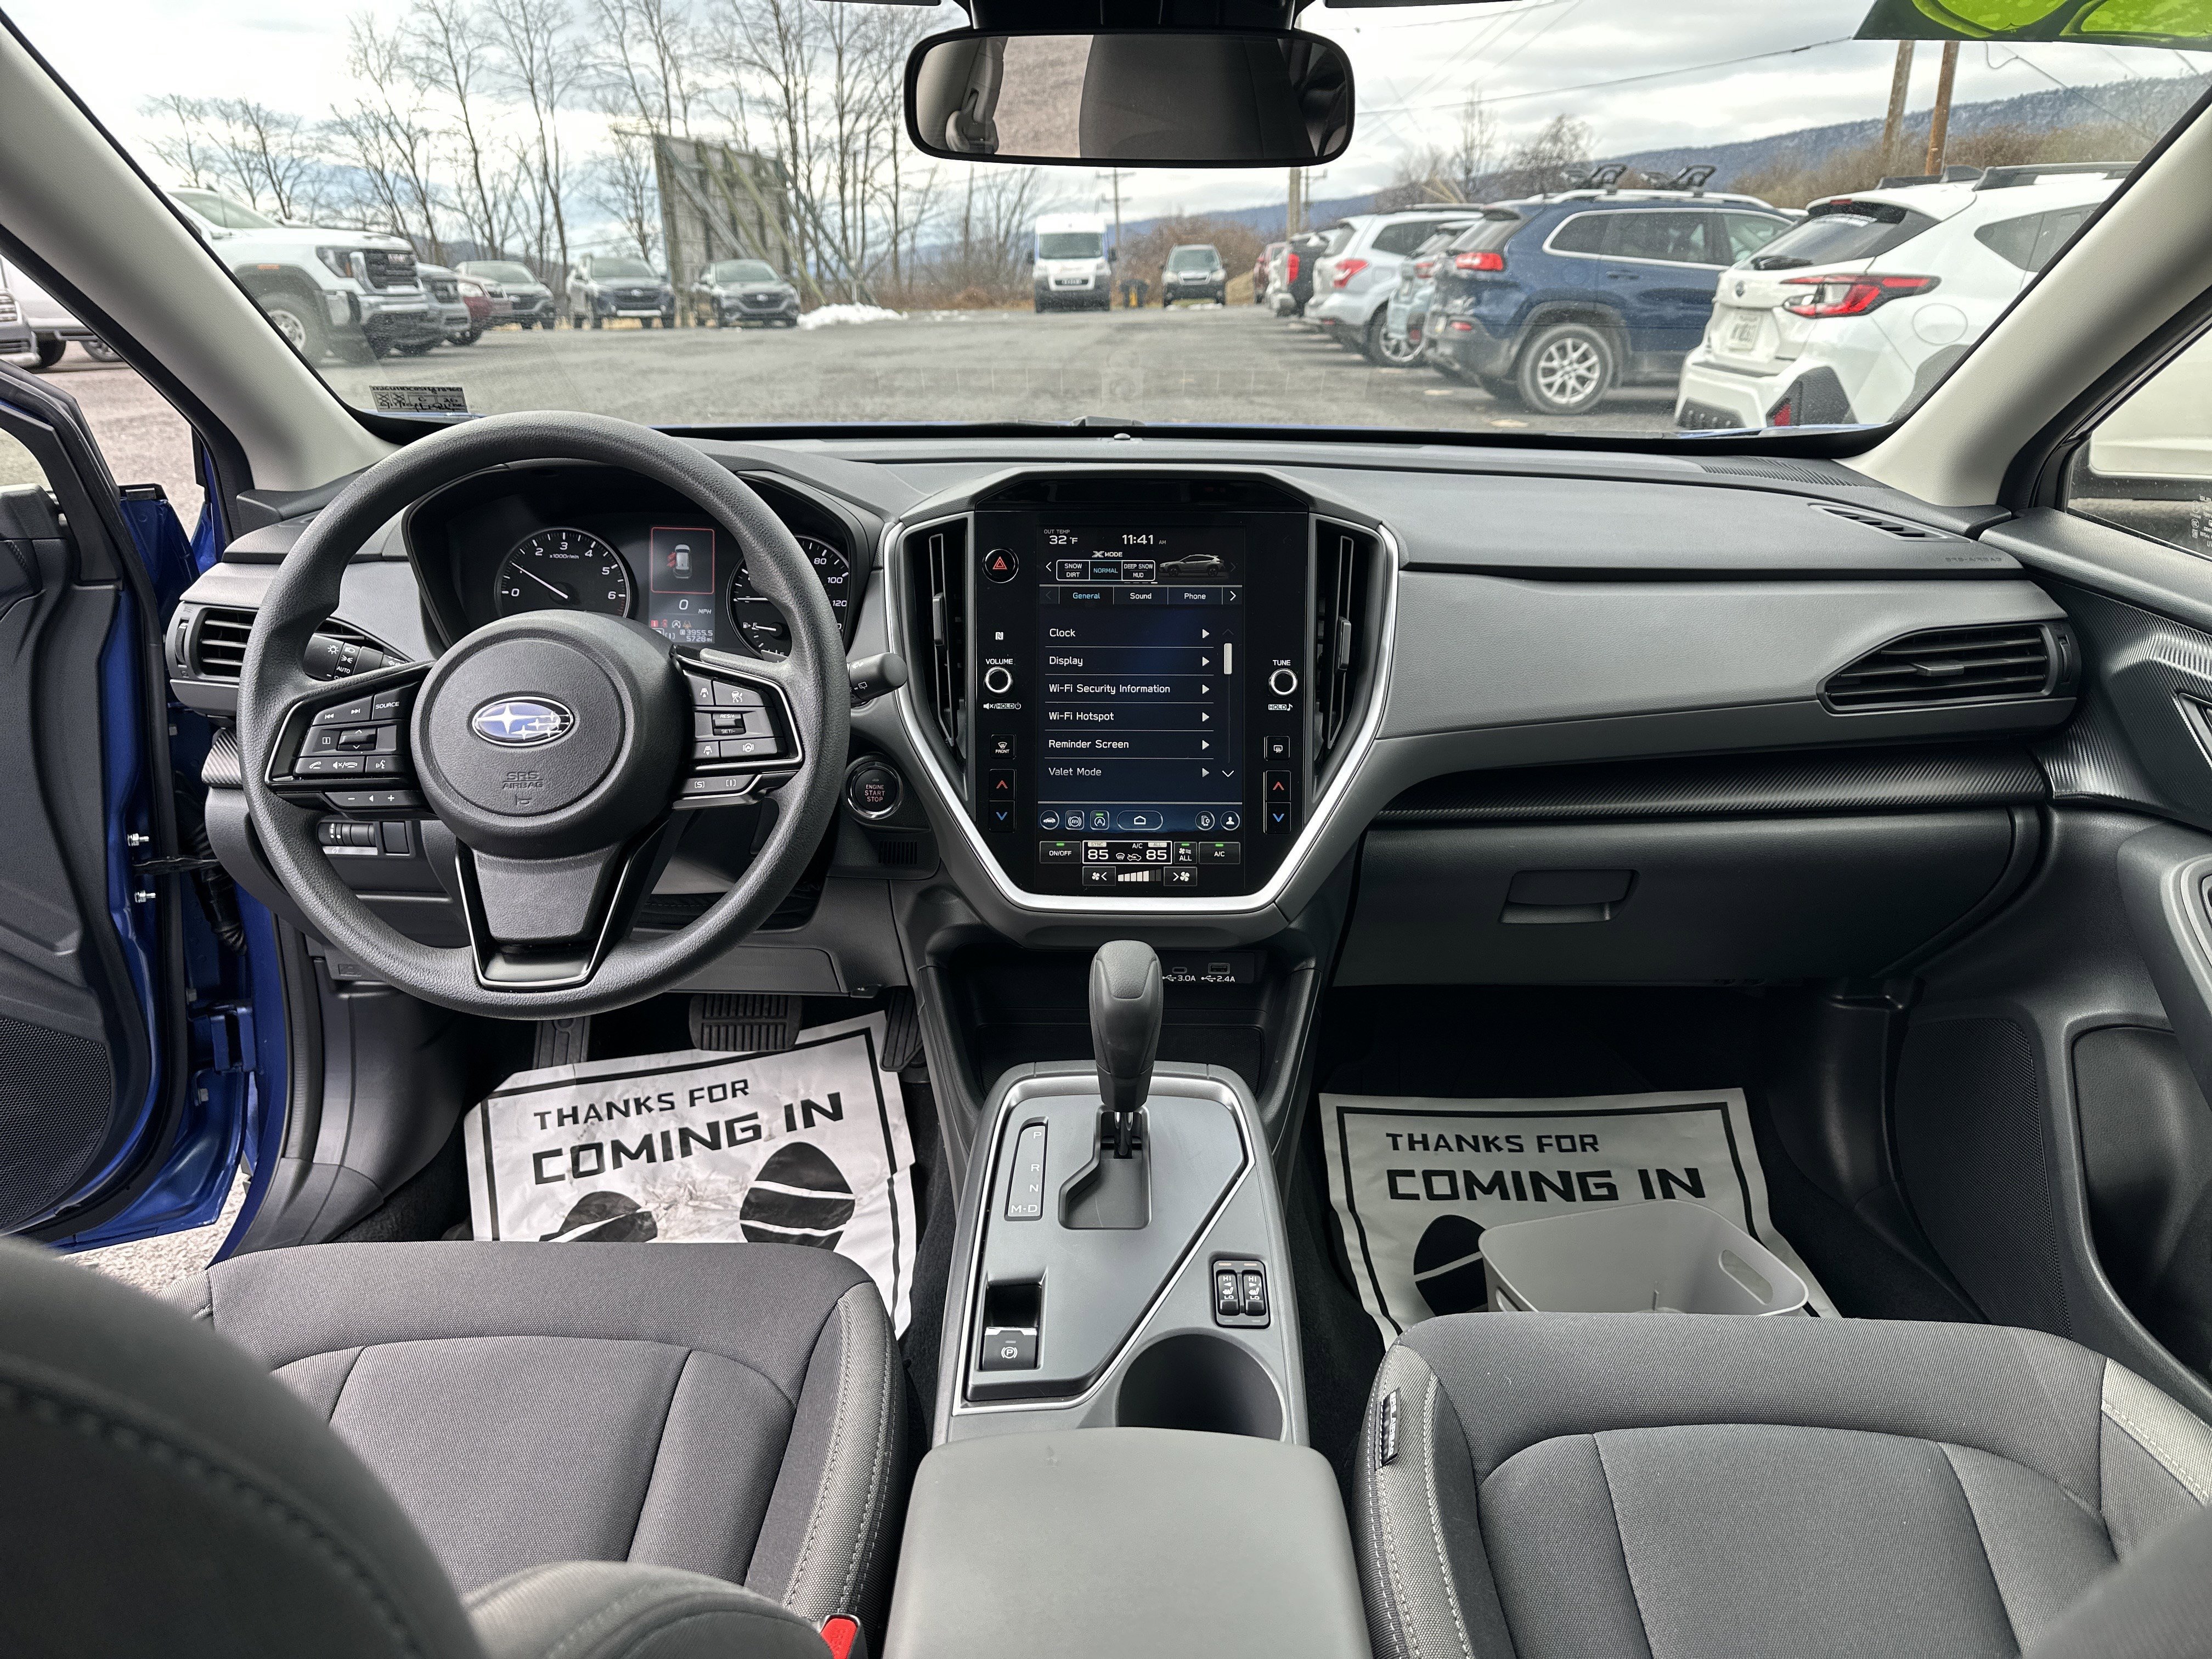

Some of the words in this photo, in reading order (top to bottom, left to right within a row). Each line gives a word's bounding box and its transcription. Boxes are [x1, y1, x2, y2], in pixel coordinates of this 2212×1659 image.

[1049, 535, 1067, 545] 32
[1122, 534, 1154, 545] 11:41
[560, 541, 568, 550] 3
[534, 548, 544, 556] 2
[584, 549, 593, 557] 4
[601, 567, 610, 575] 5
[511, 588, 520, 597] 0
[608, 591, 617, 600] 6
[679, 599, 689, 610] 0
[1049, 628, 1076, 637] Clock
[1049, 656, 1083, 667] Display
[336, 665, 351, 674] AUTO
[1049, 684, 1073, 693] Wi-Fi
[1076, 684, 1116, 695] Security
[1119, 684, 1171, 693] Information
[375, 701, 400, 709] SOURCE
[1049, 712, 1073, 720] Wi-Fi
[1076, 712, 1115, 723] Hotspot
[1048, 740, 1091, 749] Reminder
[1095, 740, 1130, 749] Screen
[506, 771, 540, 781] SRS
[1048, 767, 1073, 776] Valet
[1077, 767, 1102, 776] Mode
[1087, 849, 1109, 860] 85
[1146, 849, 1167, 861] 85
[534, 1092, 675, 1131] THANKS
[689, 1078, 751, 1108] FOR
[533, 1111, 763, 1185] COMING
[785, 1092, 844, 1132] IN
[1385, 1132, 1524, 1153] THANKS
[1536, 1133, 1600, 1153] FOR
[1030, 1164, 1040, 1172] R
[1029, 1184, 1039, 1192] N
[1386, 1169, 1620, 1202] COMING
[1638, 1167, 1706, 1200] IN
